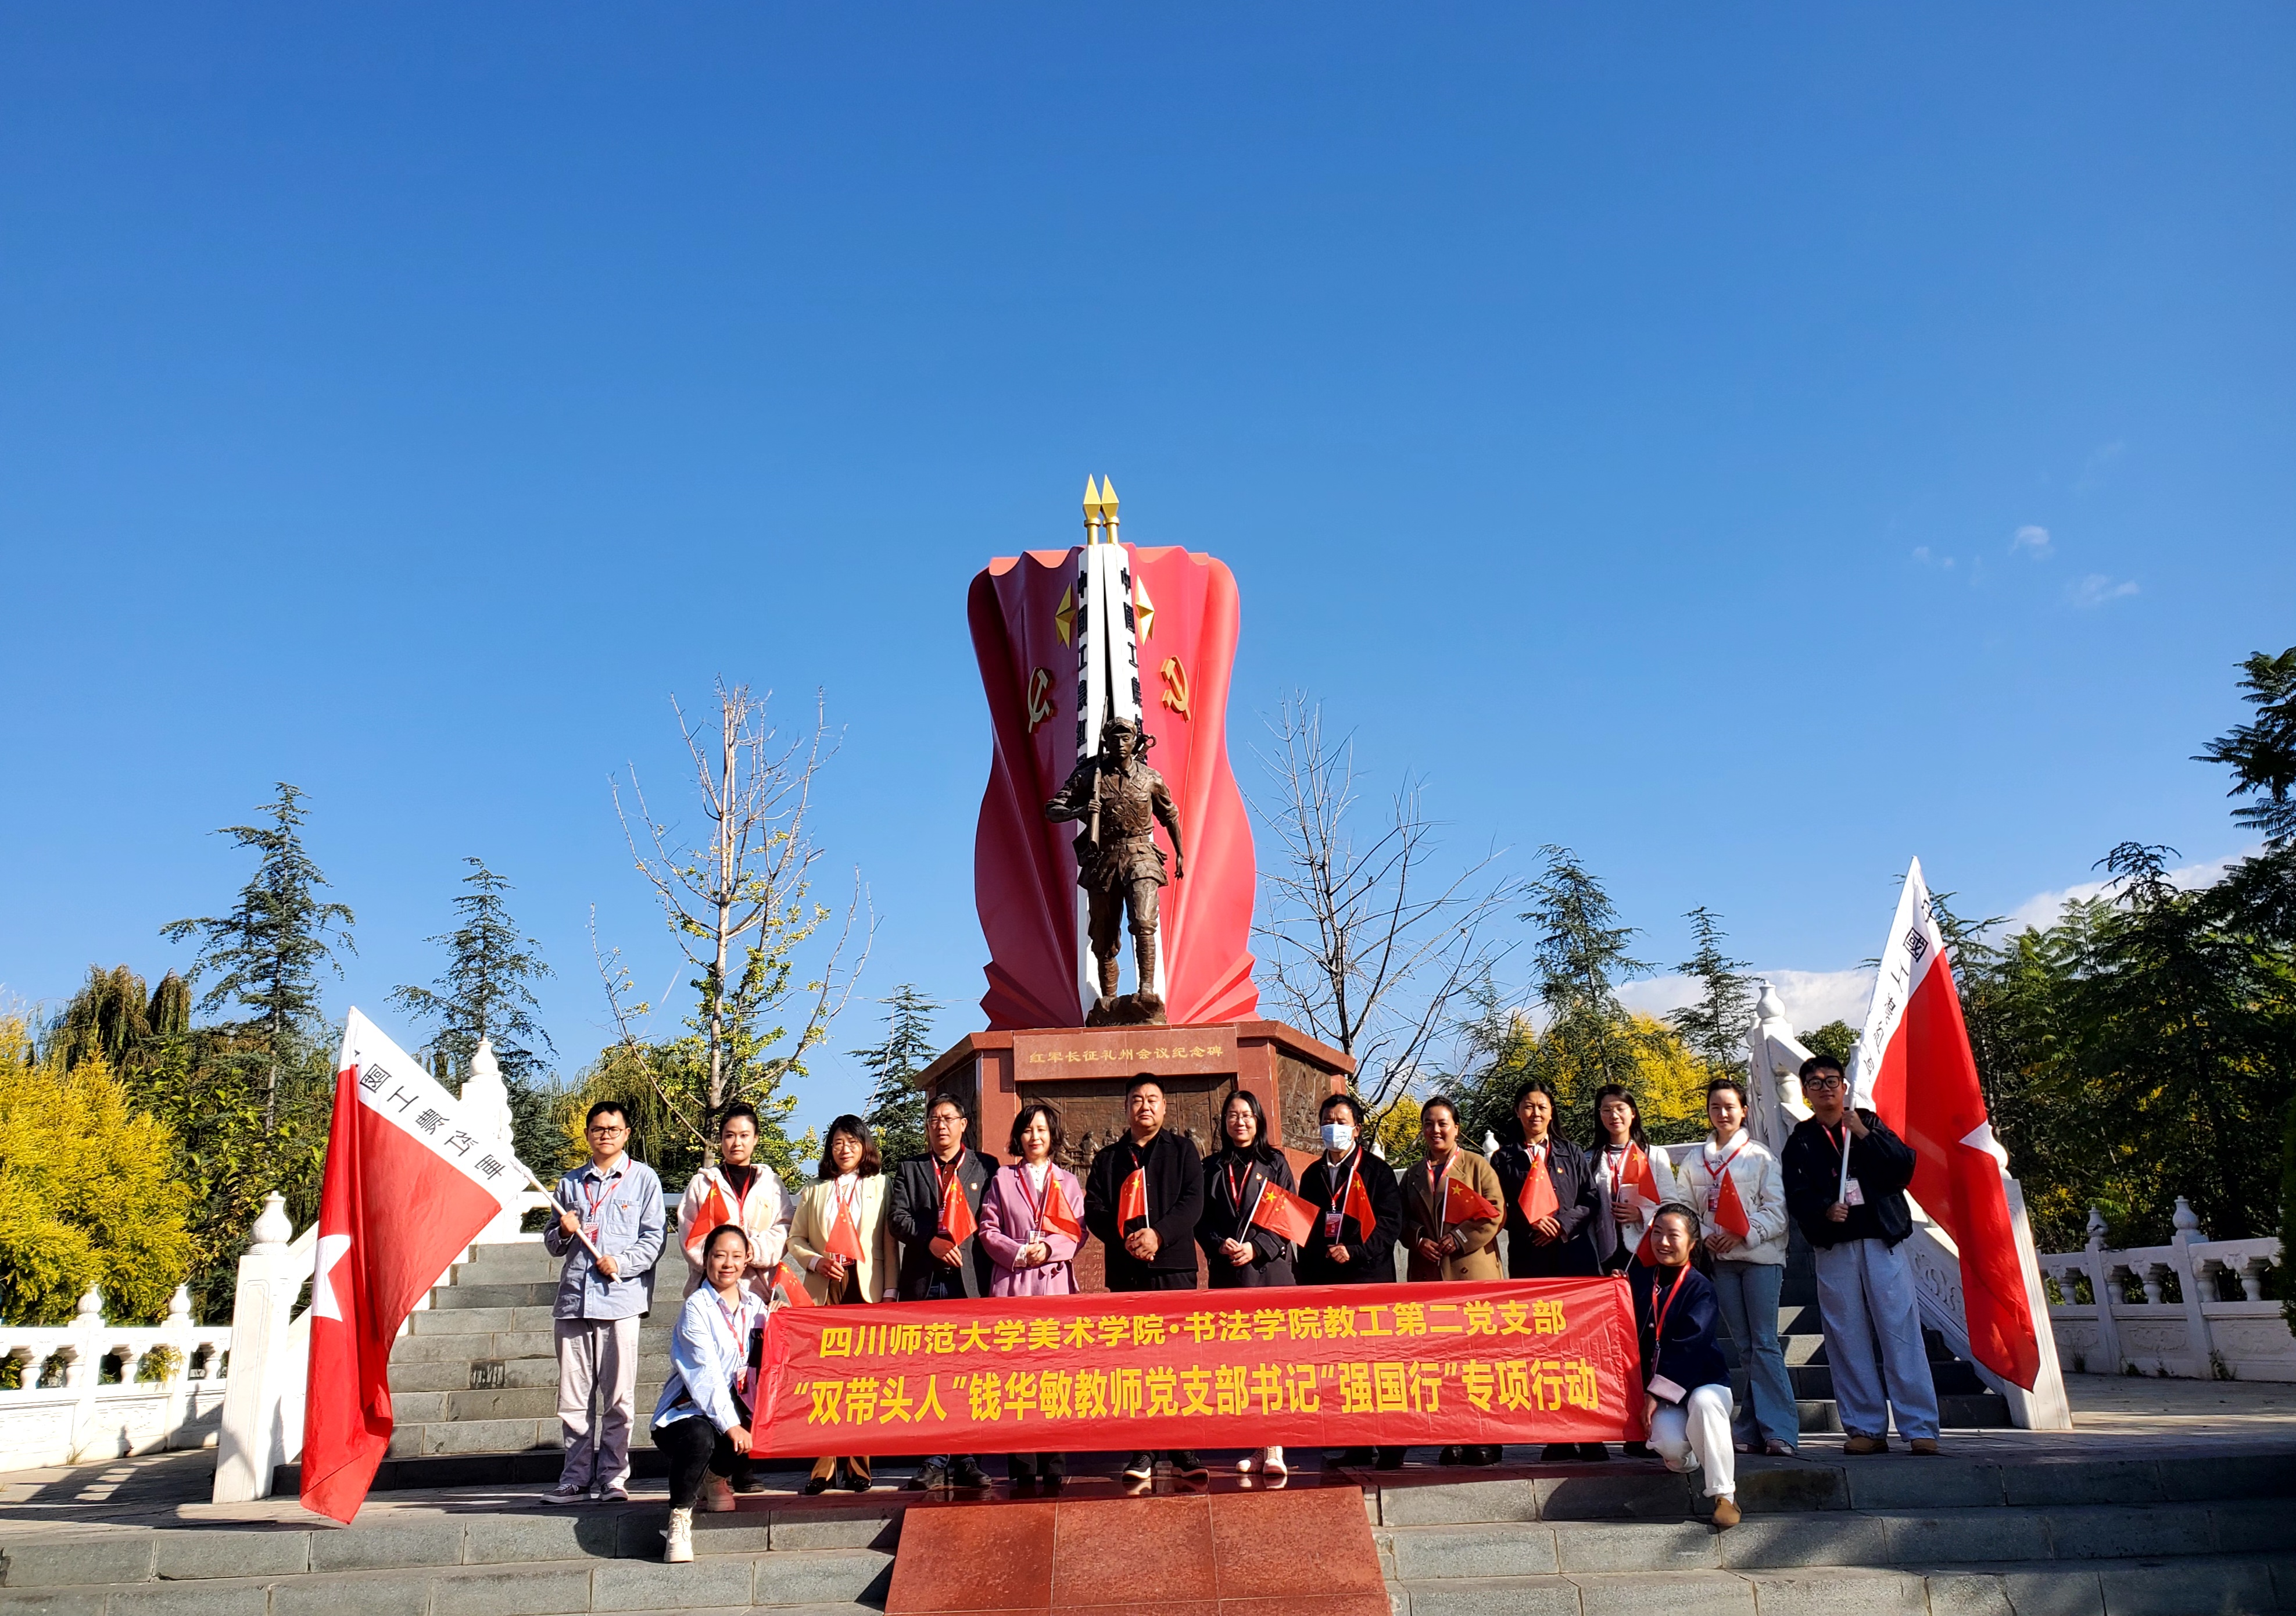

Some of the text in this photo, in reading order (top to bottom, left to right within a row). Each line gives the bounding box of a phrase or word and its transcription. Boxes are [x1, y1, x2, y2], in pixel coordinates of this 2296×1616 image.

[1029, 1045, 1223, 1063] 红军长征礼州会议纪念碑
[820, 1299, 1567, 1358] 四川师范大学美术学院·书法学院教工第二党支部
